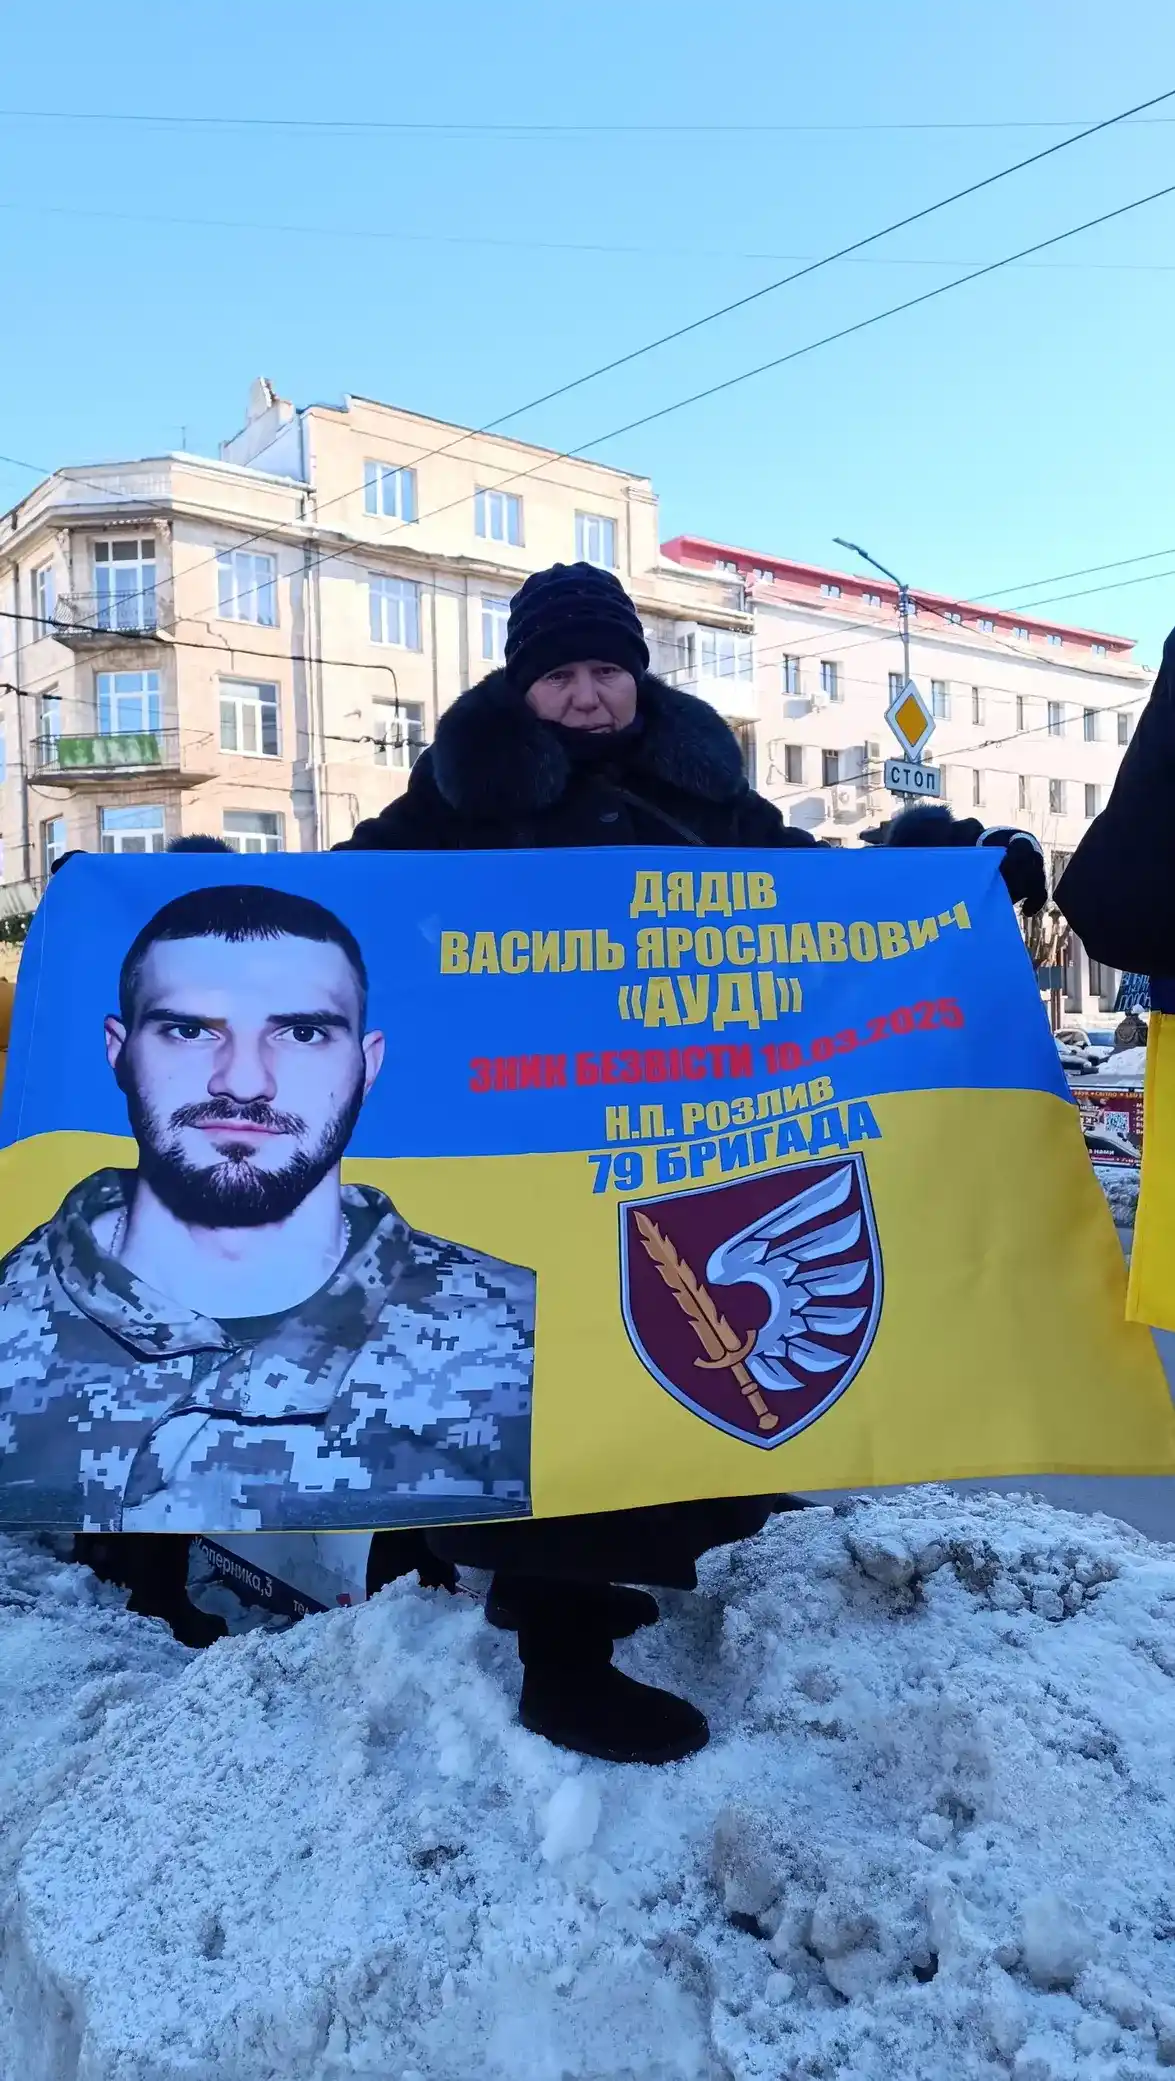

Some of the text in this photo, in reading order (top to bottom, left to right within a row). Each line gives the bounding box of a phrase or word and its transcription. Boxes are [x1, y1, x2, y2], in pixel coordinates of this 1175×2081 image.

[891, 766, 935, 790] СТОП
[630, 871, 777, 918] ДЯДІВ
[440, 901, 972, 974] ВАСИЛЬ ЯРОСЛАВОВИЧ
[618, 971, 803, 1031] «АУДІ»
[469, 997, 965, 1093] ЗНИК БЕЗВІСТИ 10.03.2025
[606, 1075, 835, 1141] Н.П. РОЗЛИВ
[588, 1101, 882, 1194] 79 БРИГАДА
